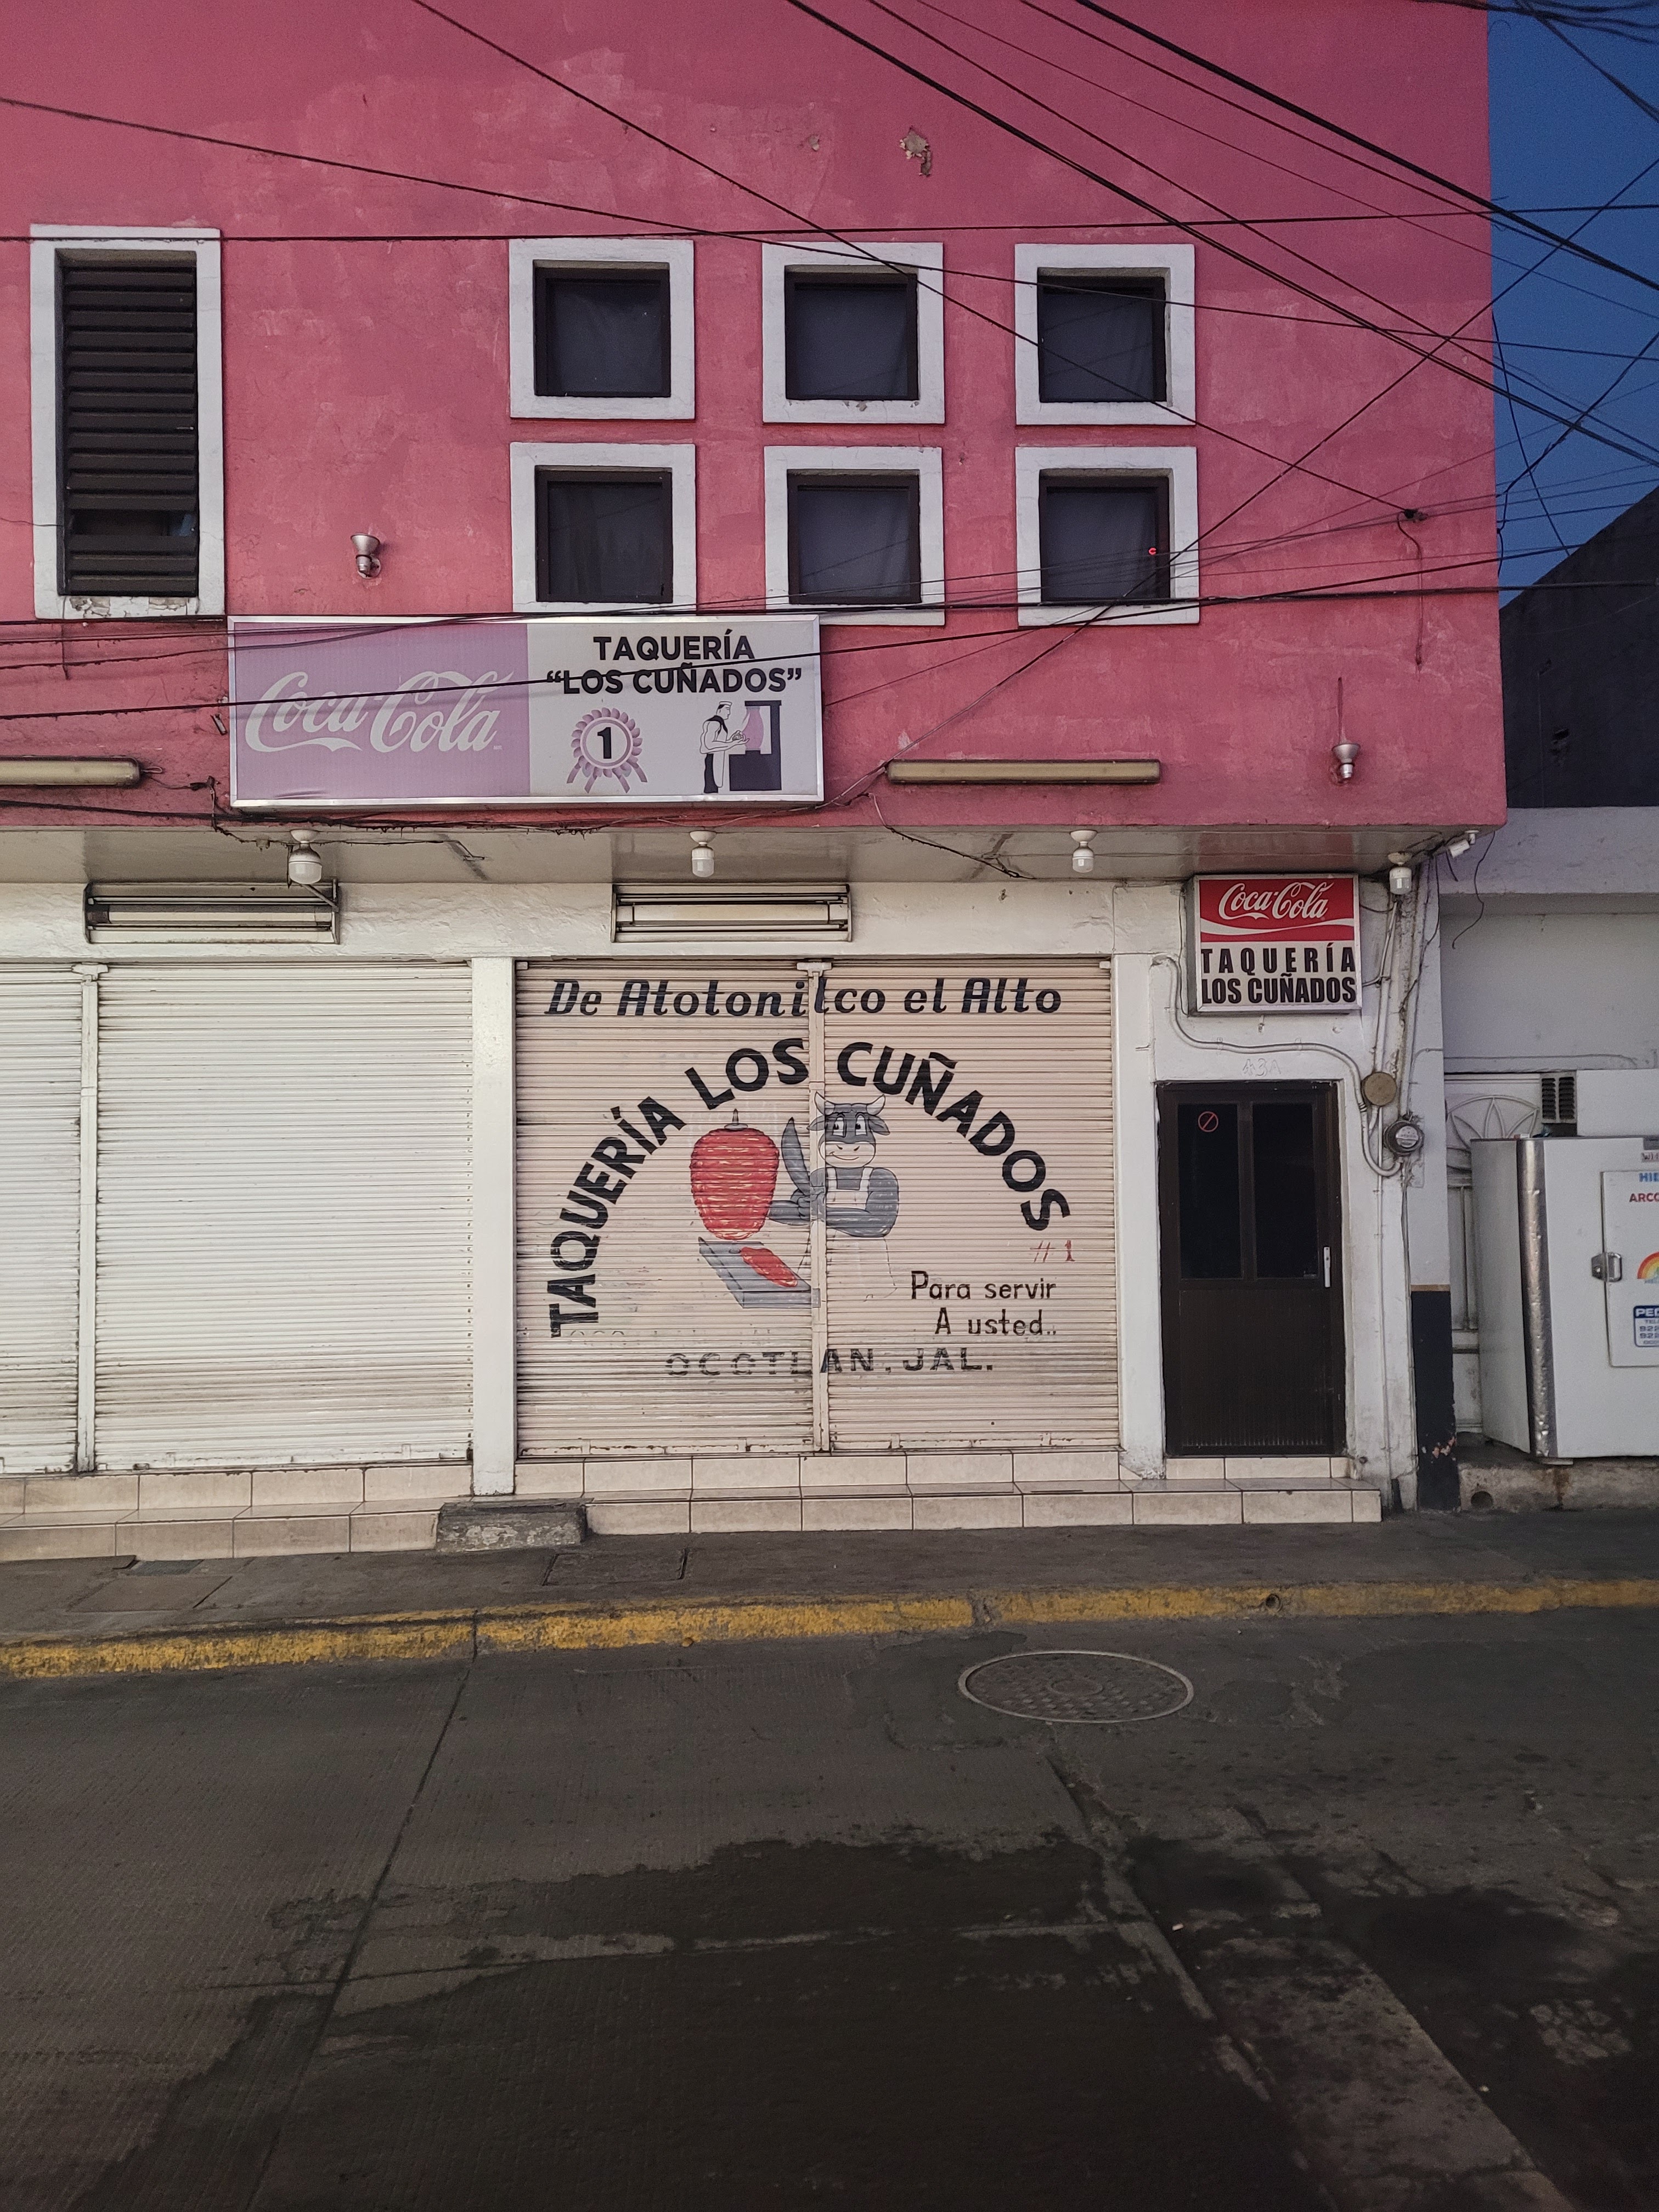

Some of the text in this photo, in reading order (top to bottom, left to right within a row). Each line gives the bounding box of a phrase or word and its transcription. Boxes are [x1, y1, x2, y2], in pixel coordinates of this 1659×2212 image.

[593, 629, 755, 661] TAQUERÍA
[597, 727, 612, 759] 1
[1218, 882, 1334, 920] Coca-Cola
[1200, 943, 1356, 975] TAQUERÍA
[544, 977, 1061, 1017] De Atotonilco el Alto
[1201, 973, 1356, 1004] LOS CUÑADOS
[548, 1038, 1070, 1338] TAQUERÍA LOS CUÑADOS
[911, 1271, 1056, 1300] Para servir
[934, 1307, 951, 1334] A
